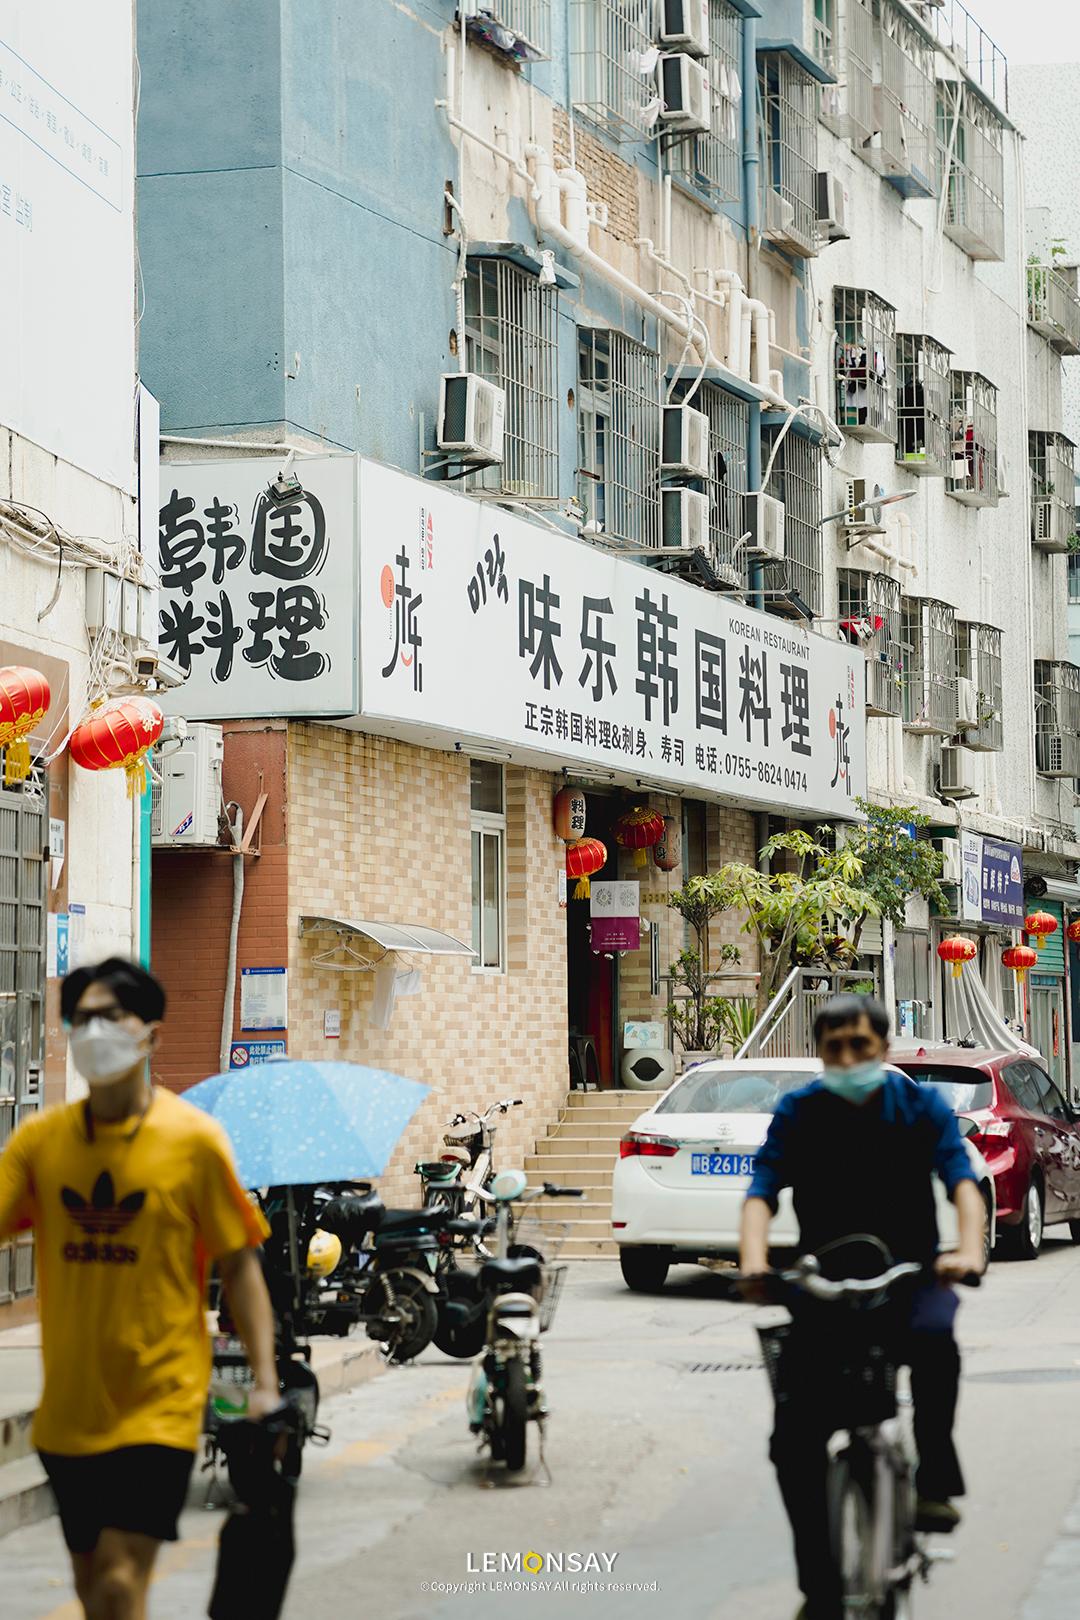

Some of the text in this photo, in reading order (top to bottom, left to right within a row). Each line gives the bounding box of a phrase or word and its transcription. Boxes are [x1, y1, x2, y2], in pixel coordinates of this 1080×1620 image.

[159, 488, 326, 596] 韩国
[159, 585, 326, 682] 料理
[518, 573, 812, 757] 味乐韩国料理
[729, 618, 811, 661] KOREAN RESTAURANT
[524, 701, 685, 767] 正宗韩国料理&刺身、寿司
[63, 1241, 139, 1267] adidas
